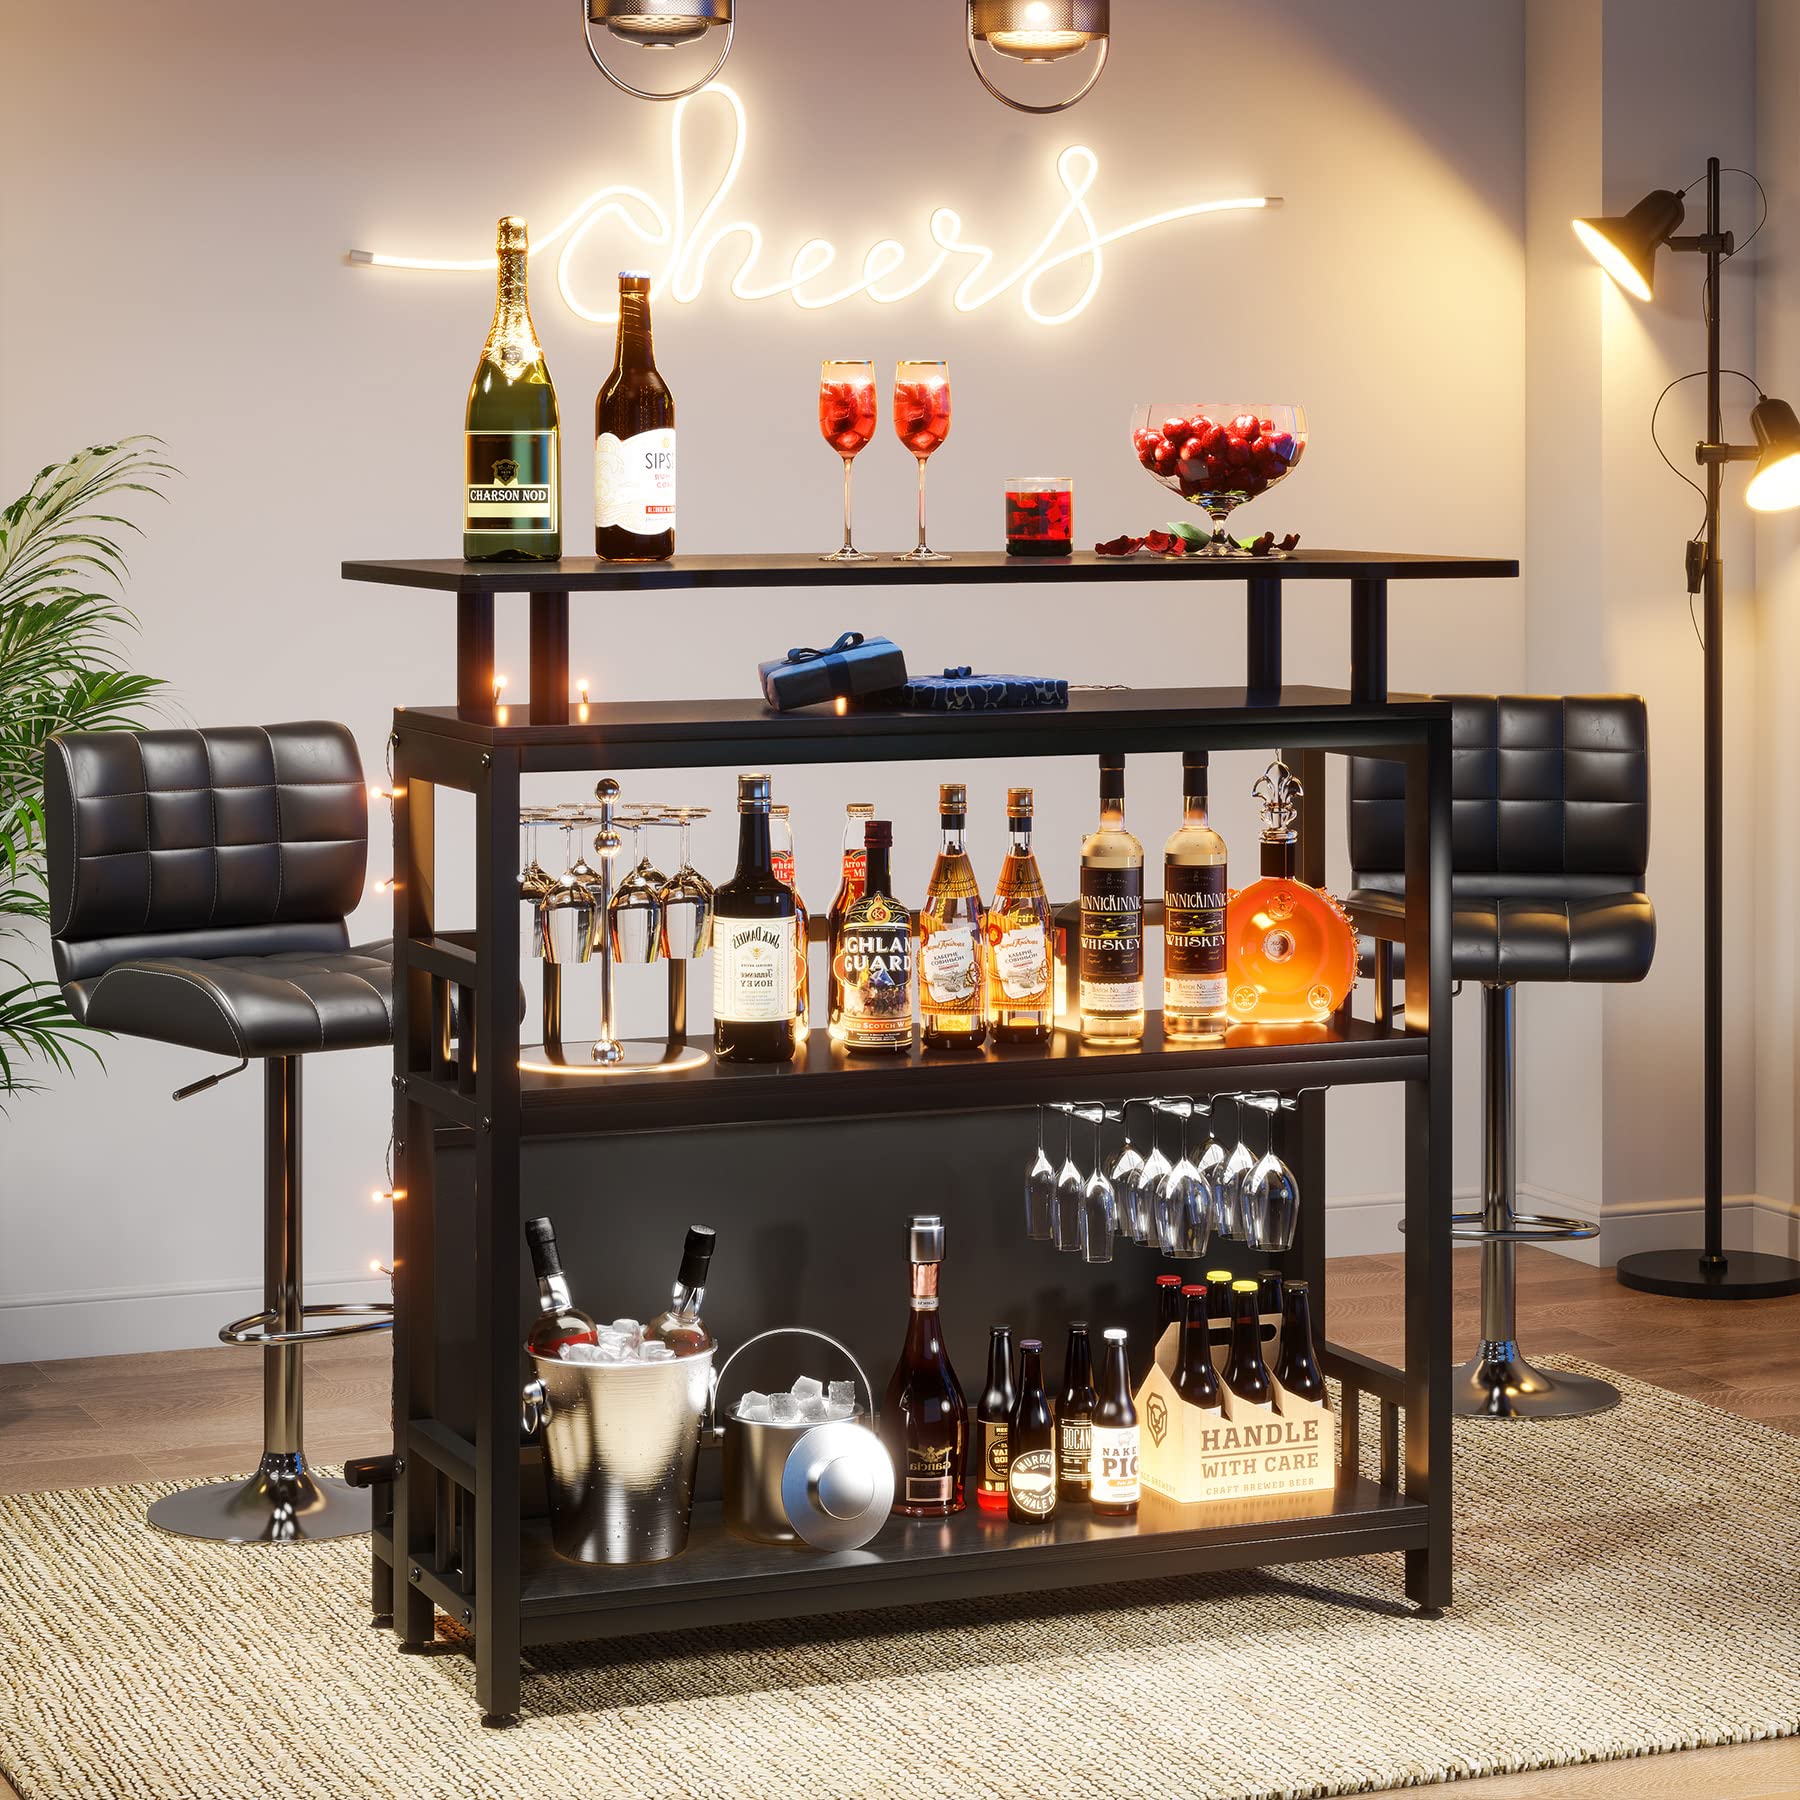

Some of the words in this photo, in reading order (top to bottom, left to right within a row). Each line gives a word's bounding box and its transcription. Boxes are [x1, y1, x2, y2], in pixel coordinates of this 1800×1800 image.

[645, 452, 673, 470] SIPS
[470, 489, 520, 502] CHARSON
[521, 489, 547, 502] NOD
[1080, 937, 1142, 951] WHISKEY
[1165, 934, 1226, 948] WHISKEY
[844, 954, 912, 972] GUARD
[863, 1021, 896, 1030] SCOTCH
[1201, 1419, 1319, 1452] HANDLE
[1201, 1458, 1257, 1479] WITH
[1264, 1452, 1319, 1473] CARE
[1206, 1485, 1239, 1496] CRAFT
[1243, 1480, 1285, 1492] BREWED
[1289, 1477, 1315, 1488] BEER
